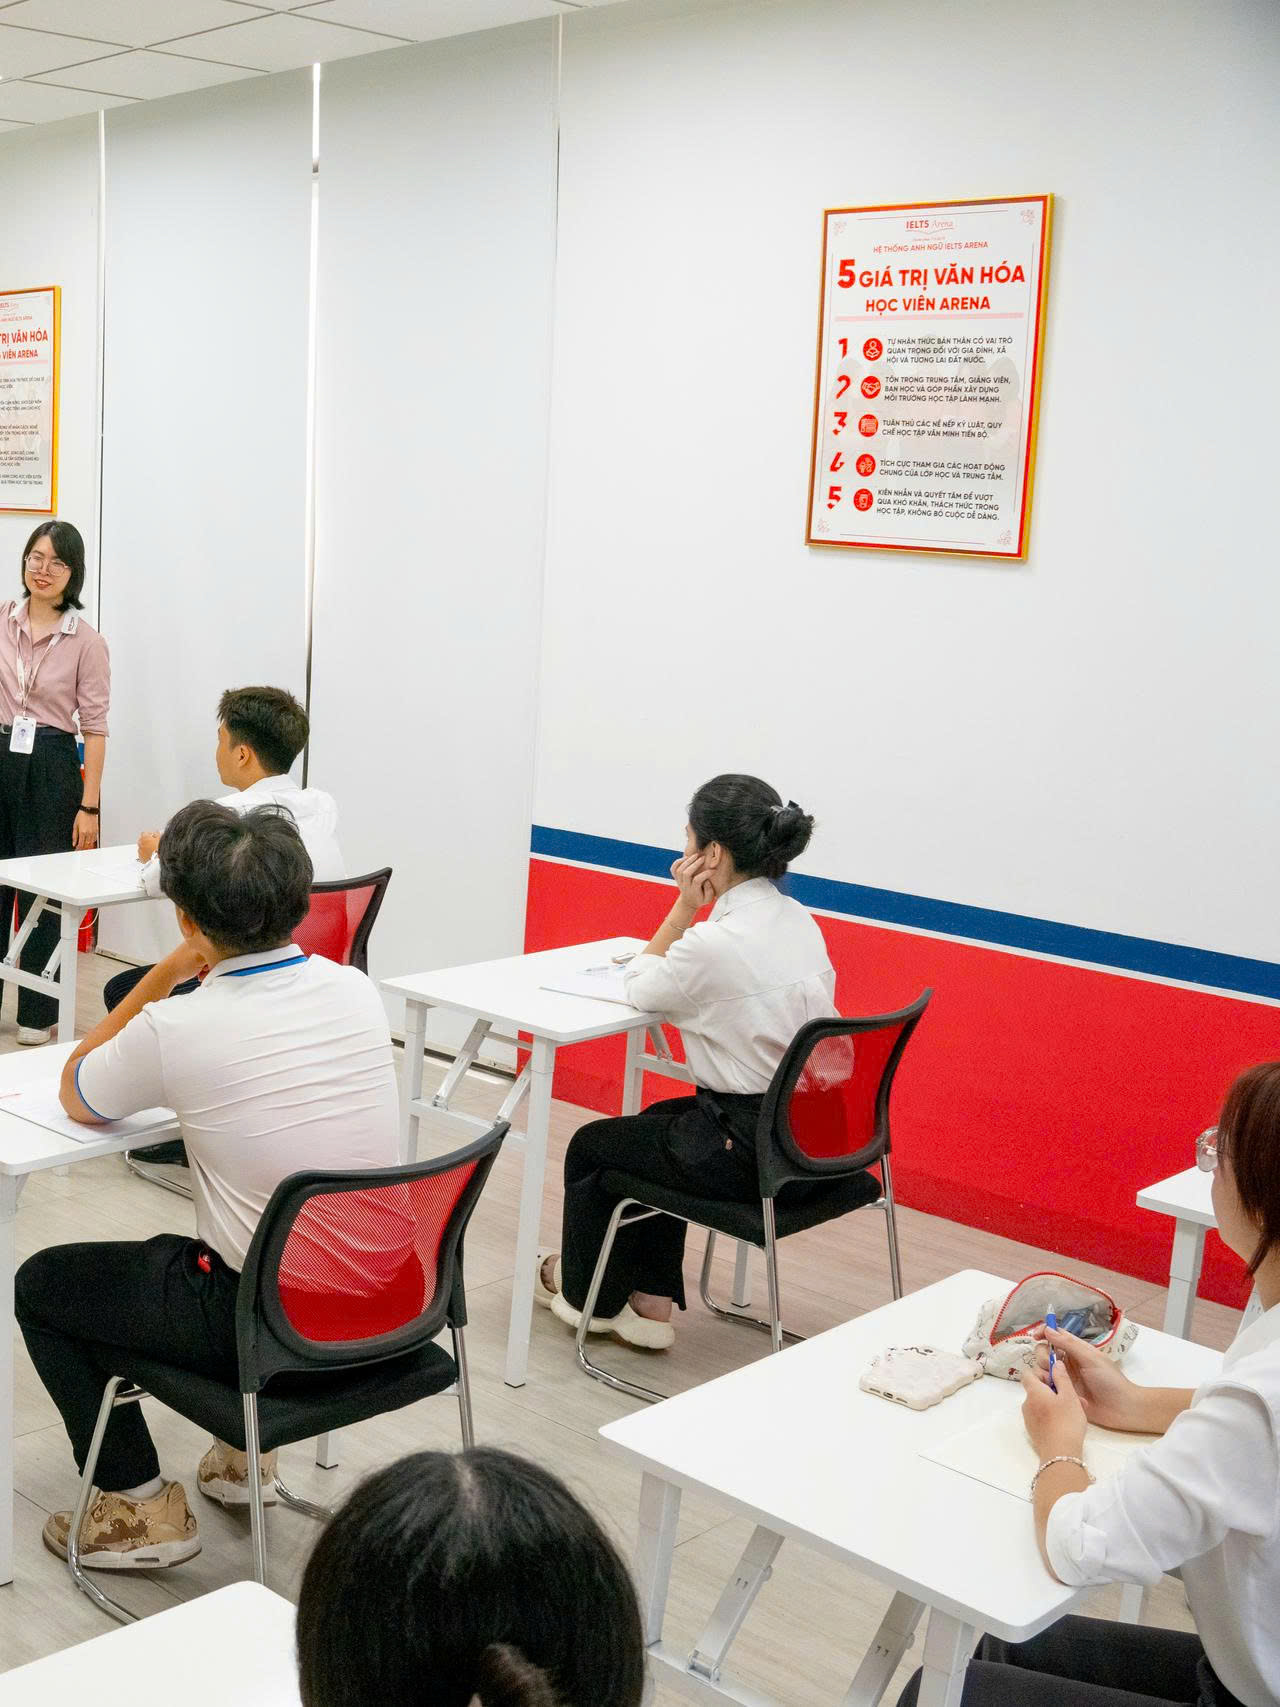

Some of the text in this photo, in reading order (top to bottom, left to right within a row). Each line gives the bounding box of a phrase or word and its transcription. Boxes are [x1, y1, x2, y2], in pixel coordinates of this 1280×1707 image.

[905, 220, 930, 229] IELTS
[945, 242, 963, 250] IELTS
[964, 241, 988, 249] ARENA
[836, 258, 1026, 291] 5 GIÁ TRỊ VĂN HÓA
[865, 294, 991, 316] HỌC VIÊN ARENA
[30, 327, 48, 341] HÓA
[2, 350, 16, 360] VIÊN
[17, 349, 38, 359] ARENA
[838, 338, 848, 359] 1
[832, 411, 847, 436] 3
[879, 468, 903, 476] CHUNG
[962, 472, 986, 480] TRUNG
[826, 486, 842, 510] 5
